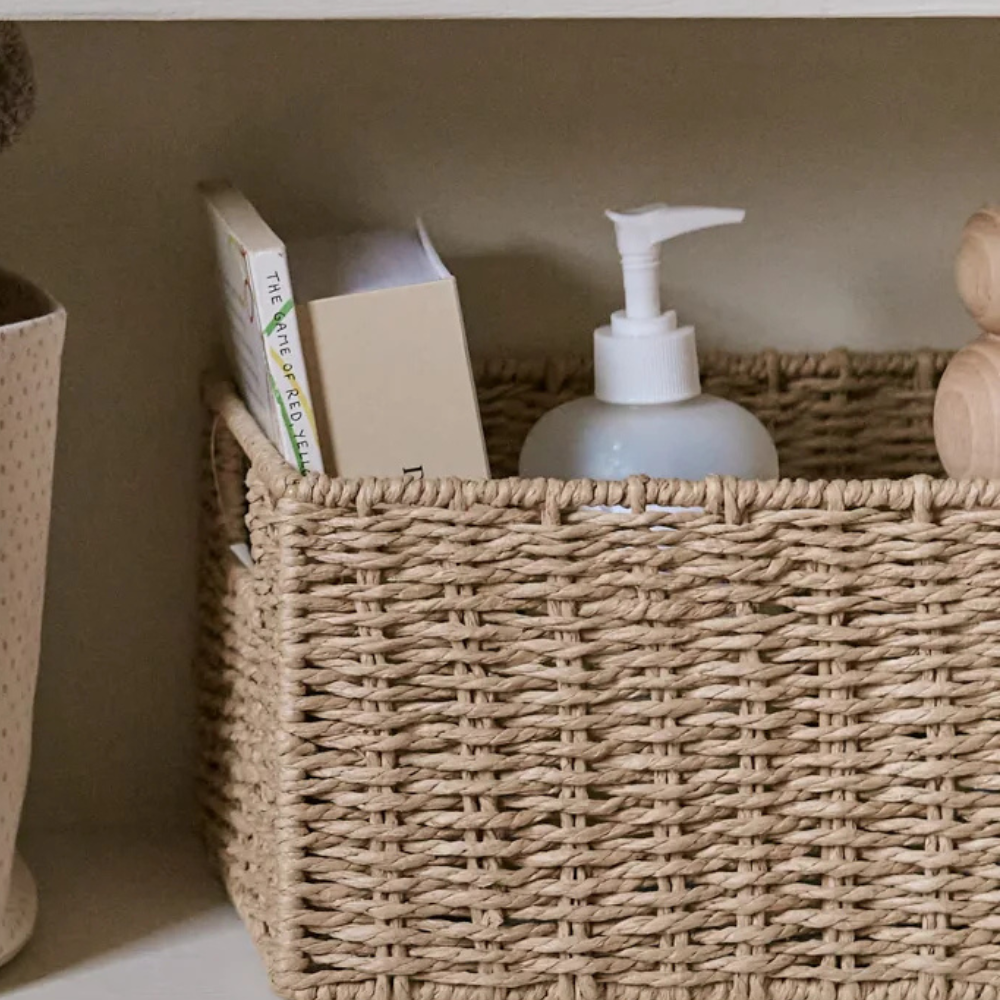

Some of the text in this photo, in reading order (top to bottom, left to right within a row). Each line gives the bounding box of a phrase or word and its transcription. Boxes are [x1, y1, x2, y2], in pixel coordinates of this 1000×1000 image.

[267, 271, 282, 305] THE
[274, 311, 291, 356] GAME
[283, 363, 295, 380] OF
